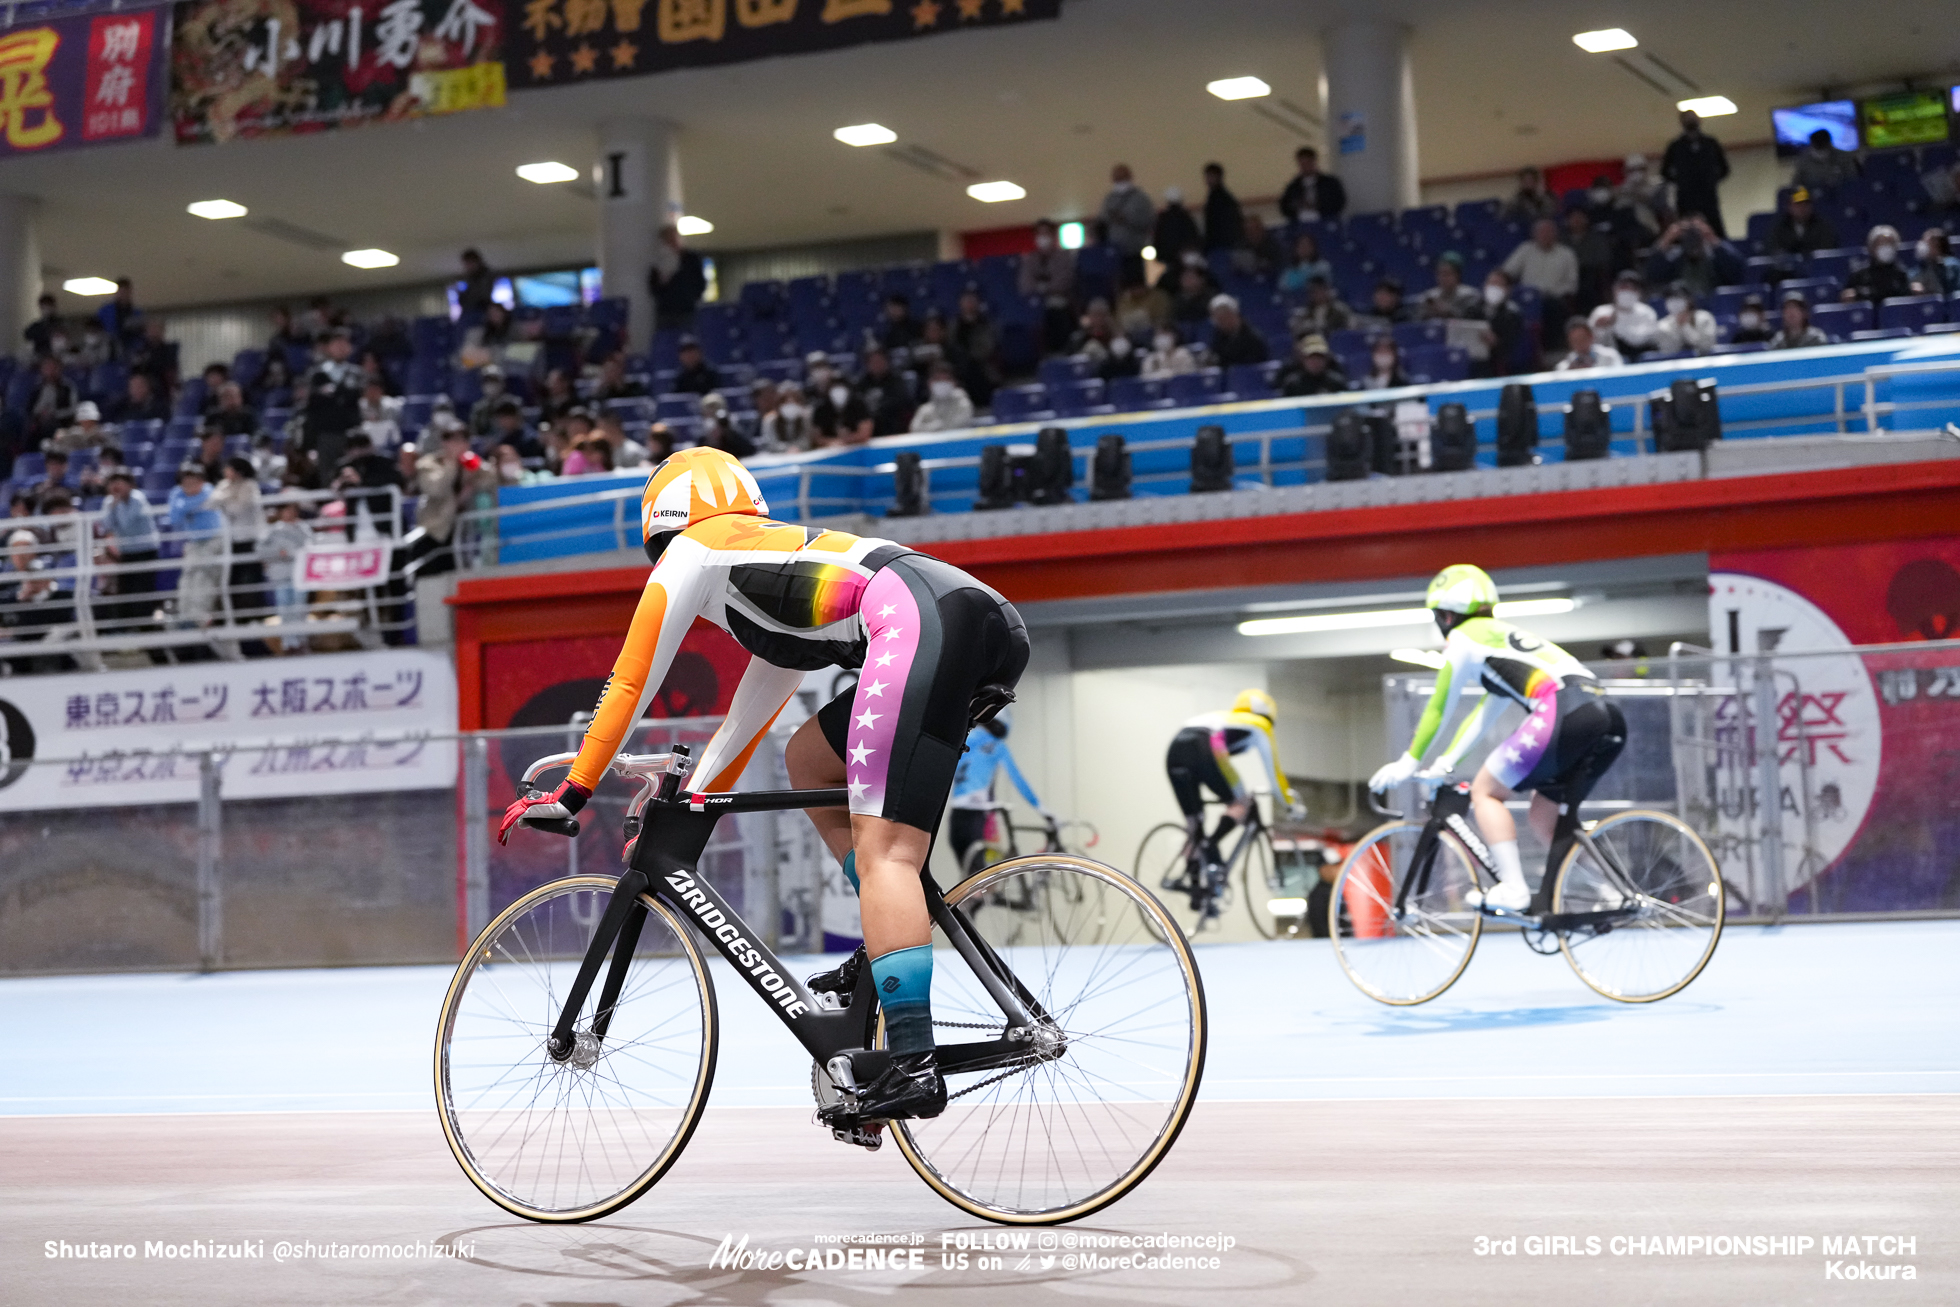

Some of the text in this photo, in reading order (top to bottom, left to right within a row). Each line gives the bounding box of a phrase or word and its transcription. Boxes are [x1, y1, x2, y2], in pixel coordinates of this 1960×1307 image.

[660, 509, 688, 519] KEIRIN
[66, 670, 422, 729] 東京スポーツ 大阪スポーツ
[664, 869, 810, 1020] BRIDGESTONE
